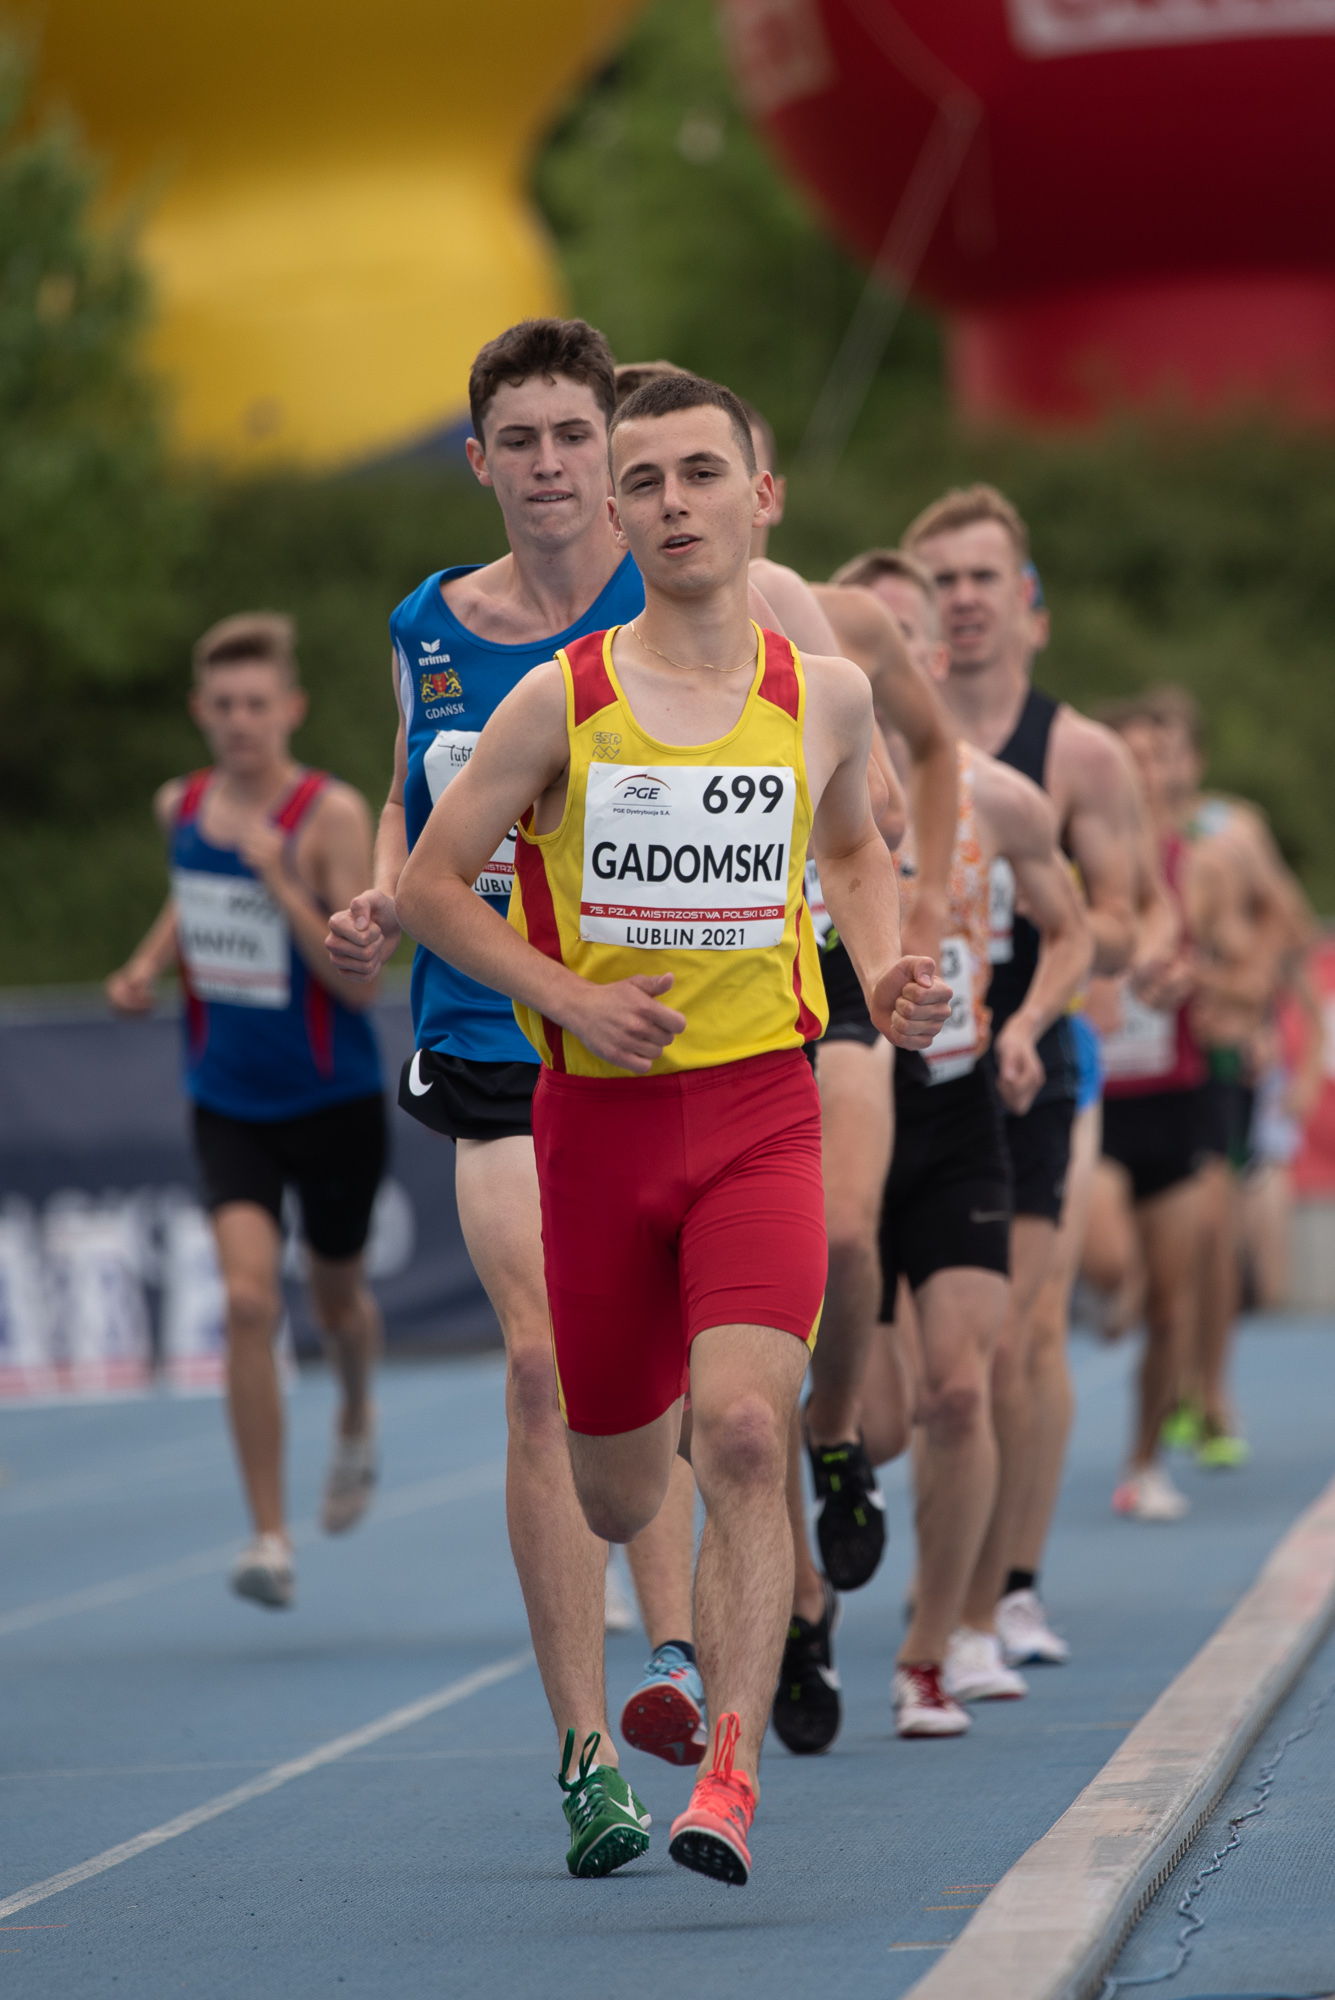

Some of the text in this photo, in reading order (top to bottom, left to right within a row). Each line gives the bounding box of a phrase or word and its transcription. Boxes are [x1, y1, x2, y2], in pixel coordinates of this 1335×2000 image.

[418, 653, 451, 667] erima
[425, 703, 466, 720] GDAŃSK
[623, 786, 661, 800] PGE
[702, 774, 784, 814] 699
[626, 808, 659, 817] Dystrybucja
[592, 841, 785, 884] GADOMSKI
[589, 906, 779, 920] 75. PZLA MISTRZOSTWA POLSKI U20
[626, 926, 745, 946] LUBLIN 2021
